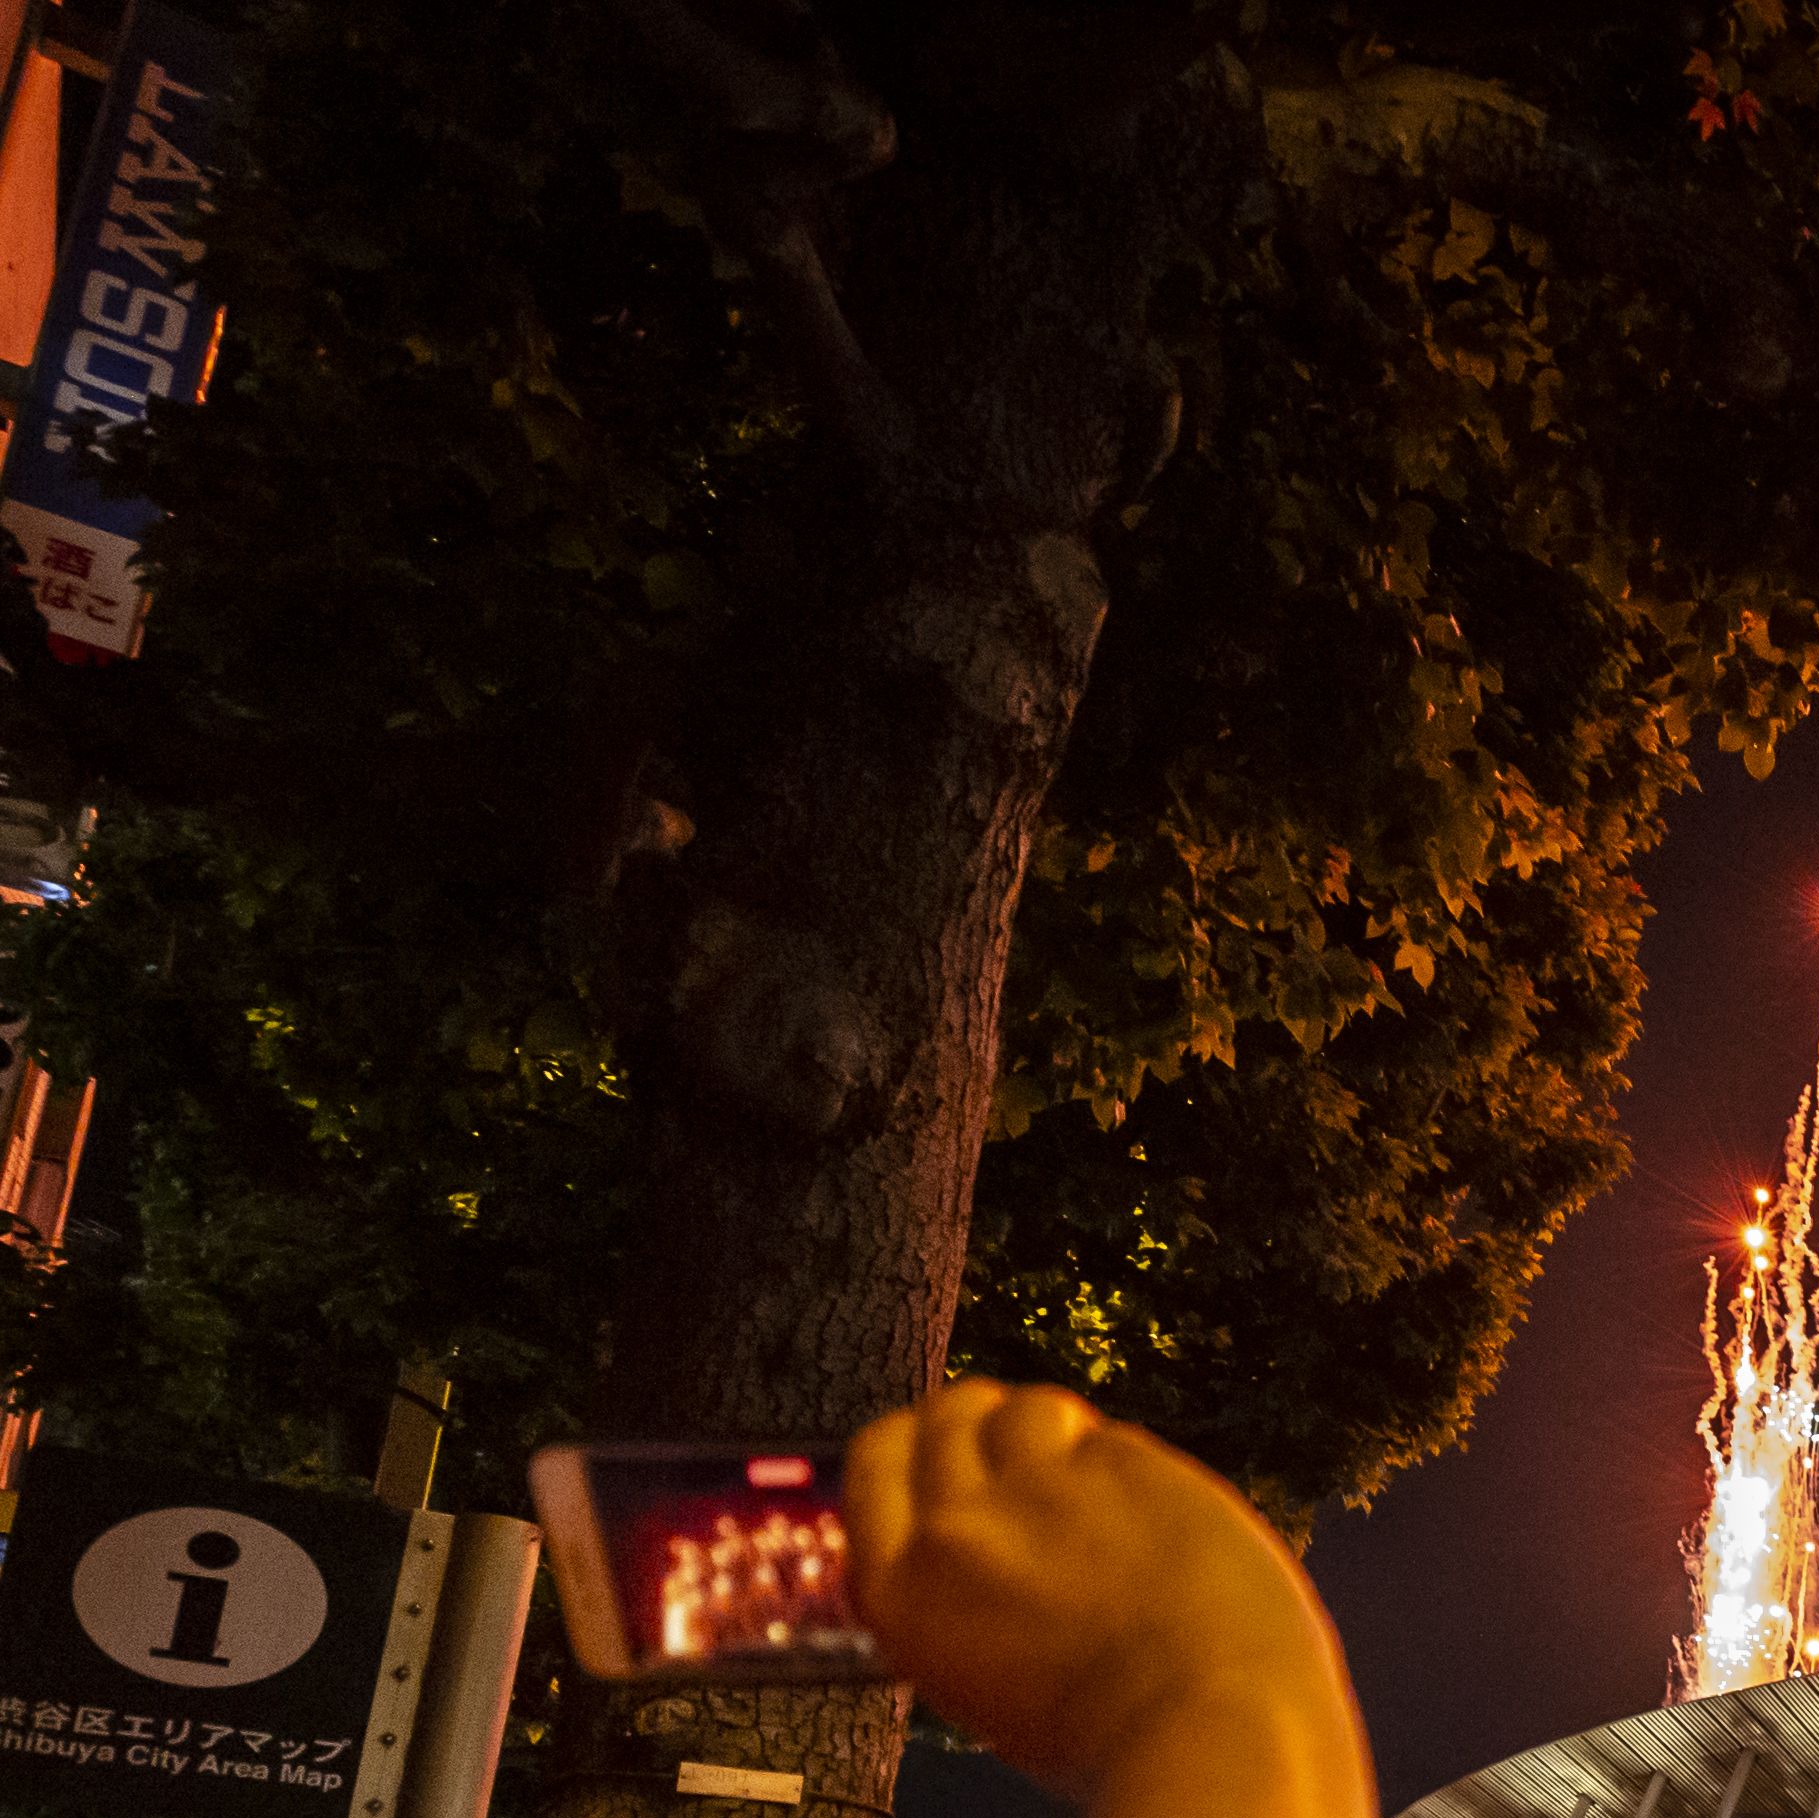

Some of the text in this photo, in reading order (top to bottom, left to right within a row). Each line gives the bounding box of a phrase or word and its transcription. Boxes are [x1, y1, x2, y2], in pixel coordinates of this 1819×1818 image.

[0, 1729, 342, 1792] hibuya City Area Map
